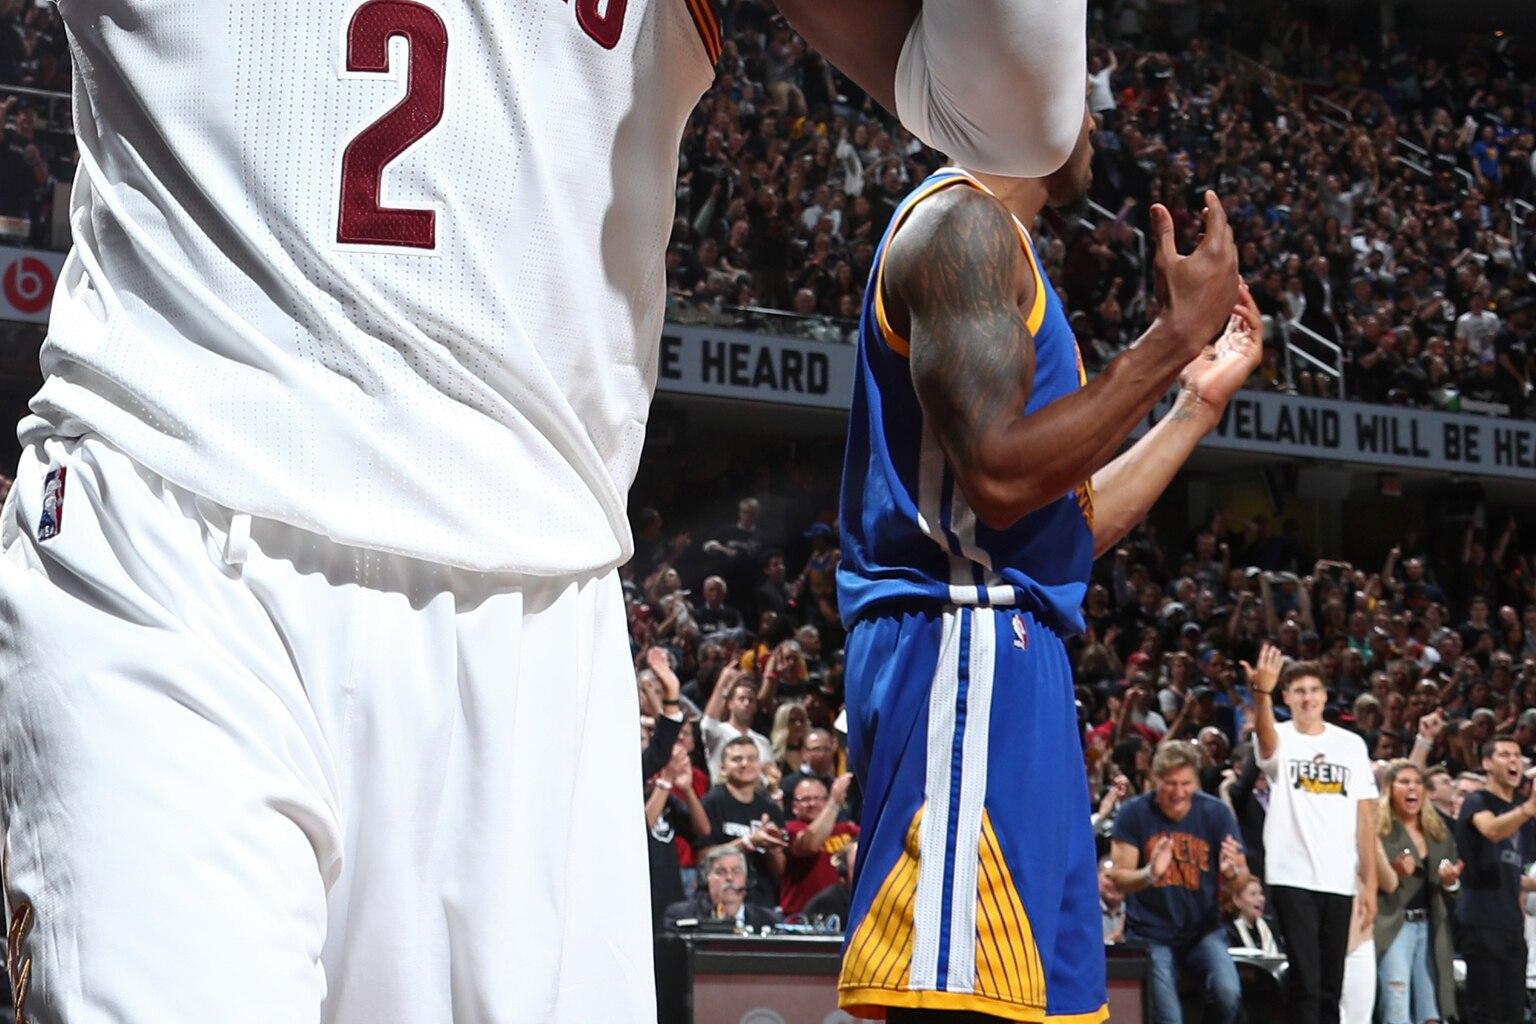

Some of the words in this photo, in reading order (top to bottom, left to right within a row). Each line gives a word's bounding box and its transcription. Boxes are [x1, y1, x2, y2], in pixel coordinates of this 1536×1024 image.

[661, 335, 683, 379] E
[701, 339, 829, 395] HEARD
[1355, 413, 1430, 458] WILL
[1443, 422, 1481, 463] BE
[1494, 427, 1536, 469] HE
